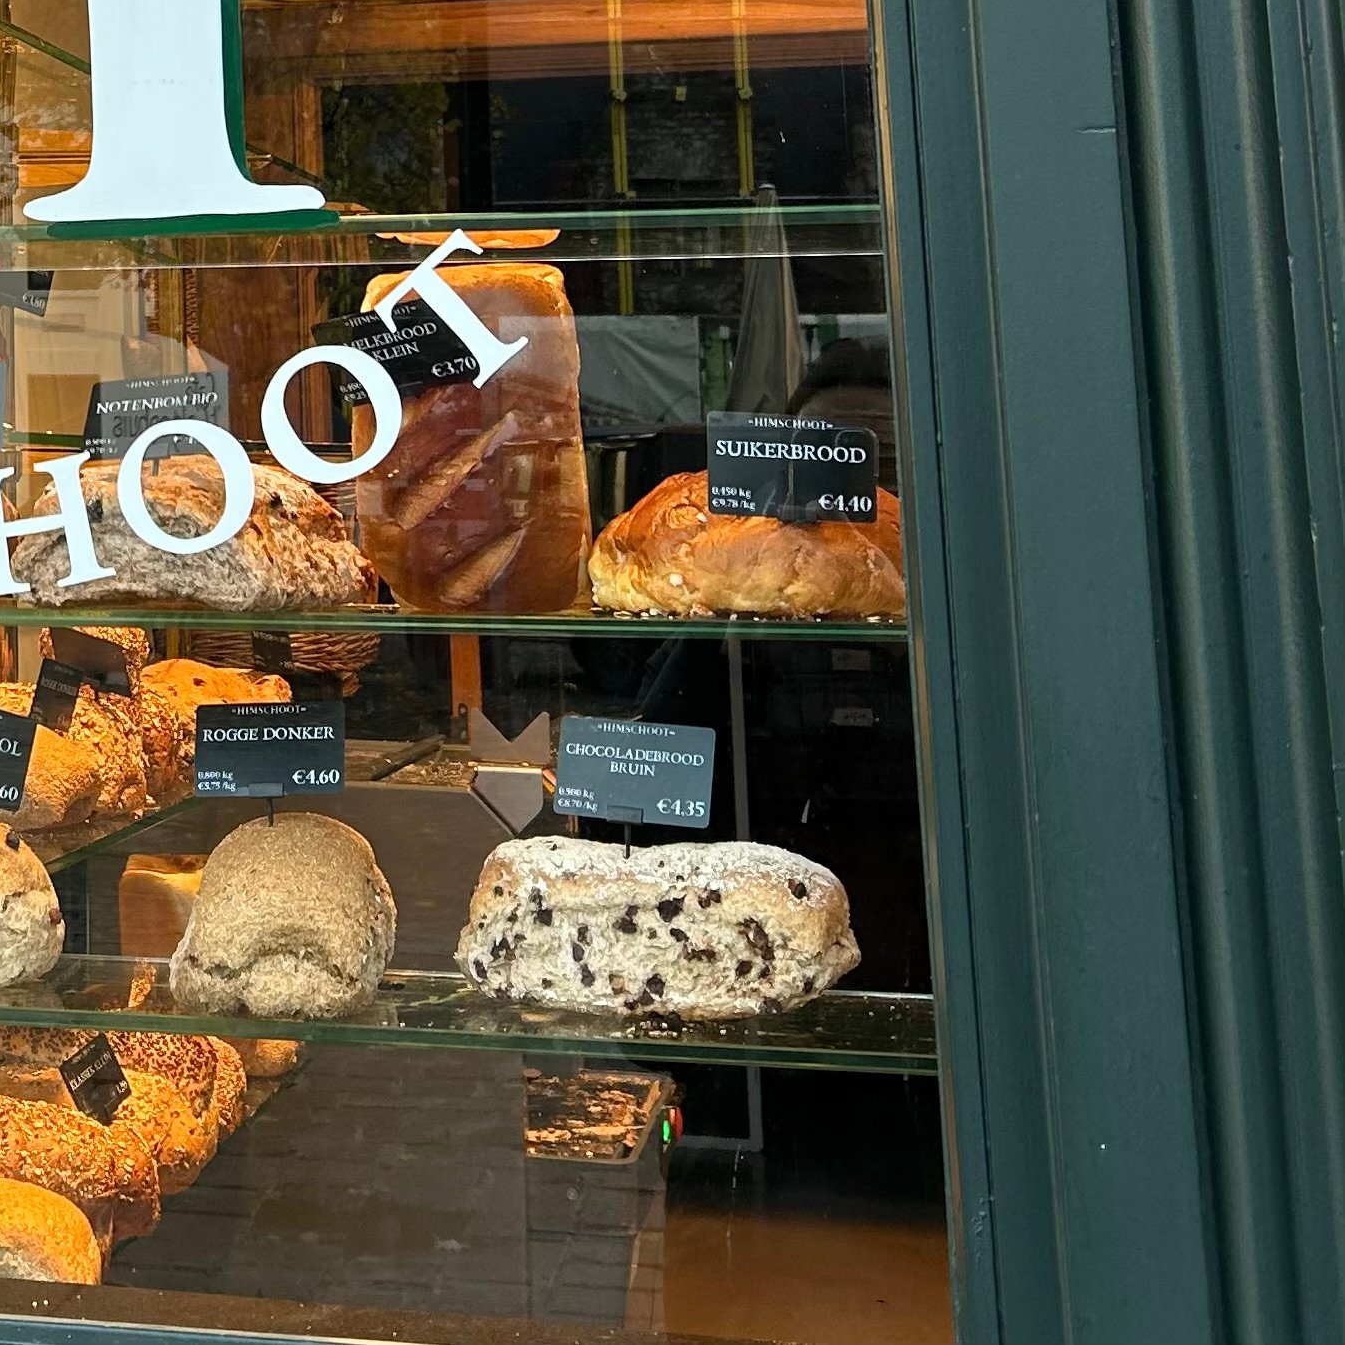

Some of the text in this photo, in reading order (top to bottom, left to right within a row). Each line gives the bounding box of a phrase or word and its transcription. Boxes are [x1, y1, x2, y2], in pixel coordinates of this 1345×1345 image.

[372, 341, 420, 361] KLEIN
[191, 391, 218, 406] BIO
[754, 417, 827, 431] HIMSCHOOT
[715, 439, 867, 464] SUIKERBROOD
[739, 487, 752, 500] kg
[236, 704, 301, 716] HIMSCHOOT
[202, 726, 335, 742] ROGGE DONKER
[602, 722, 670, 737] HIMSCHOOT
[565, 743, 705, 767] CHOCOLADEBROOD
[610, 761, 656, 777] BRUIN
